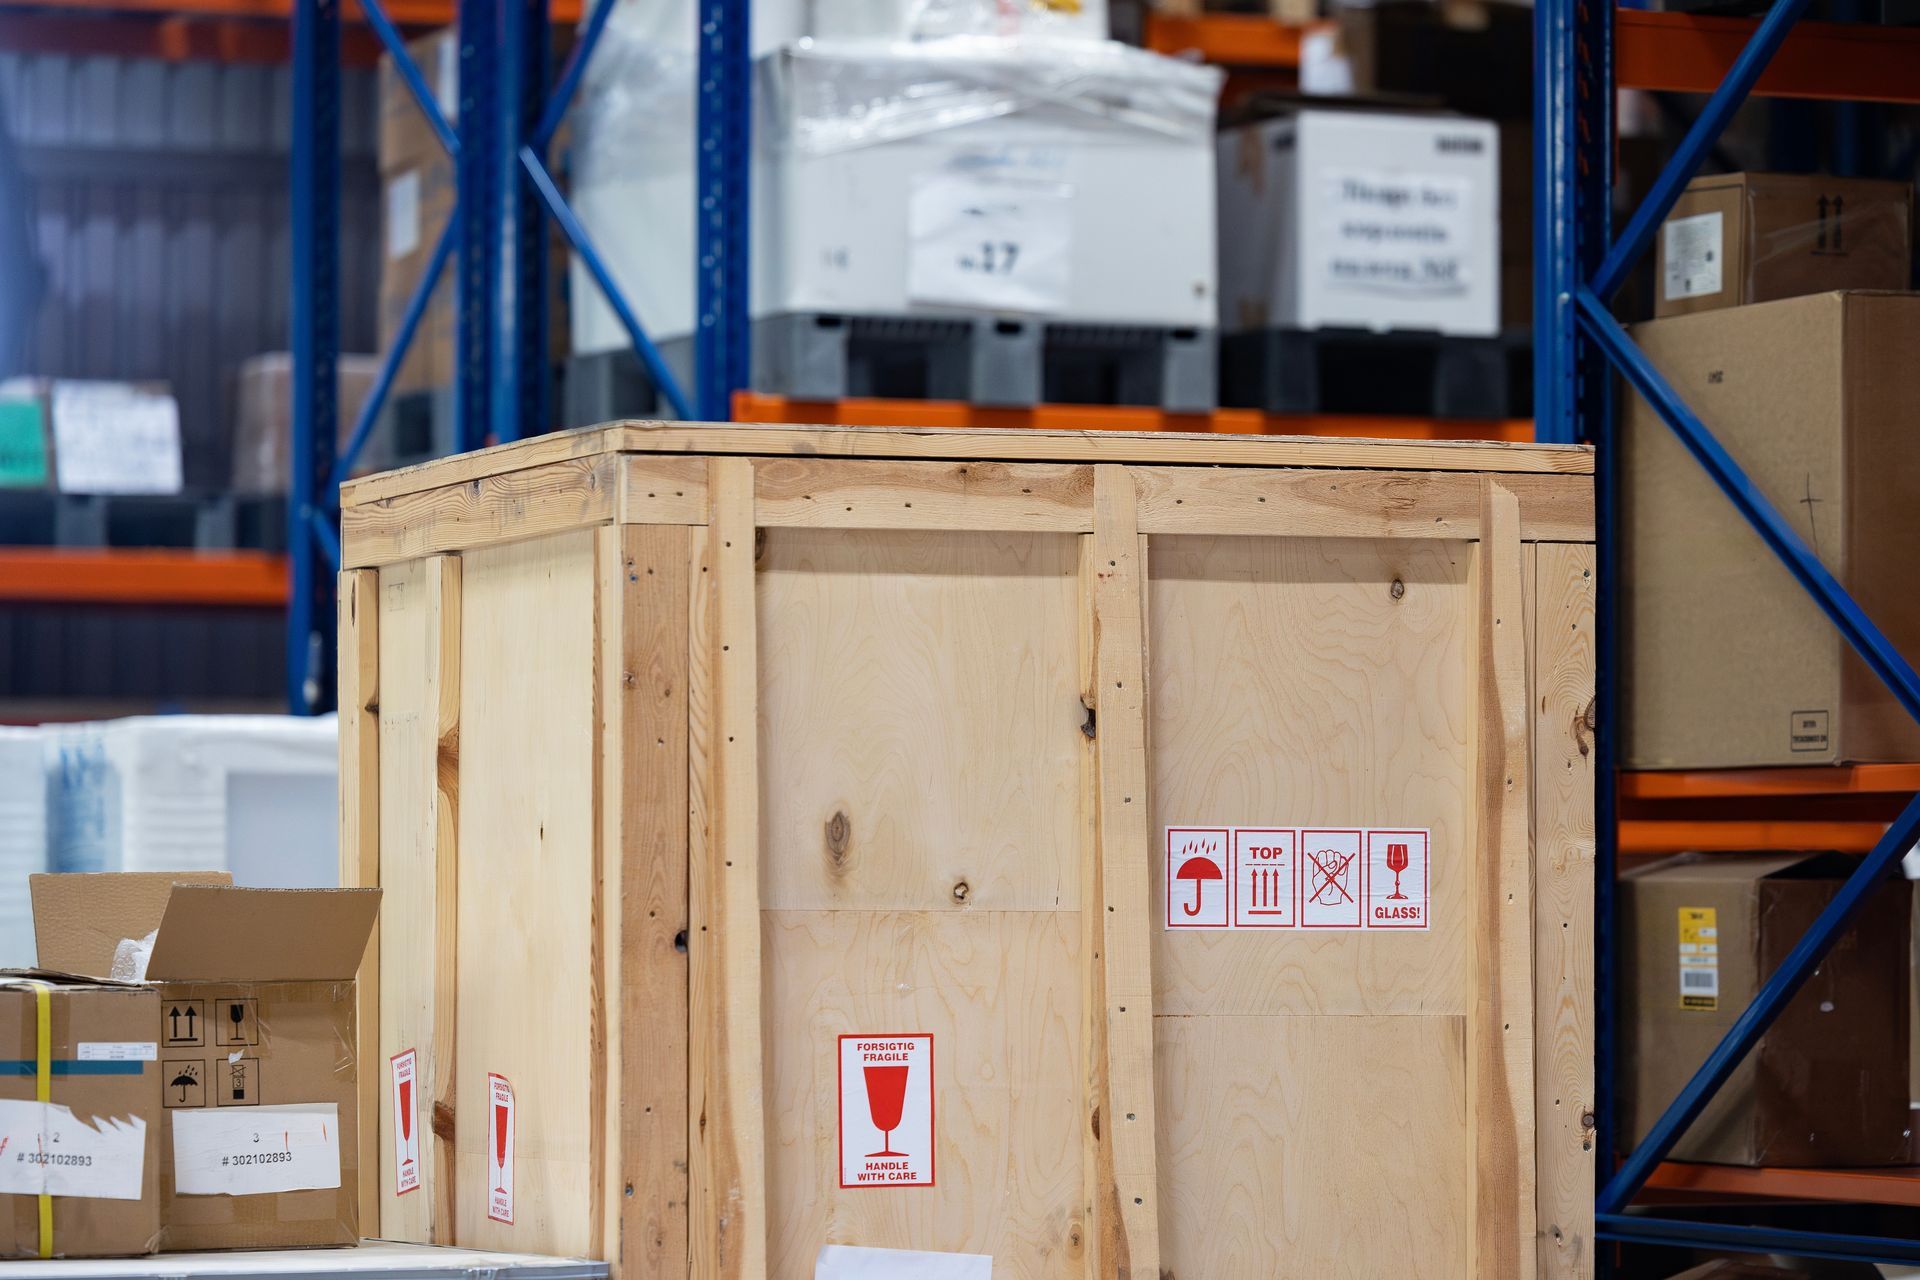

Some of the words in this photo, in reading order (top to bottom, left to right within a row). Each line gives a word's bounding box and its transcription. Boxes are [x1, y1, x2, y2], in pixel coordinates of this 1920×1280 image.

[1249, 846, 1283, 860] TOP
[1375, 906, 1421, 919] GLASS!
[857, 1042, 915, 1051] FORSIGTIG
[863, 1053, 909, 1062] FRAGILE
[52, 1132, 60, 1144] 2
[252, 1132, 260, 1144] 3
[17, 1152, 25, 1164] #
[28, 1153, 93, 1167] 302102893
[222, 1156, 230, 1167] #
[232, 1151, 293, 1166] 302102893
[865, 1162, 909, 1170] HANDLE
[857, 1173, 885, 1181] WITH
[888, 1172, 917, 1180] CARE
